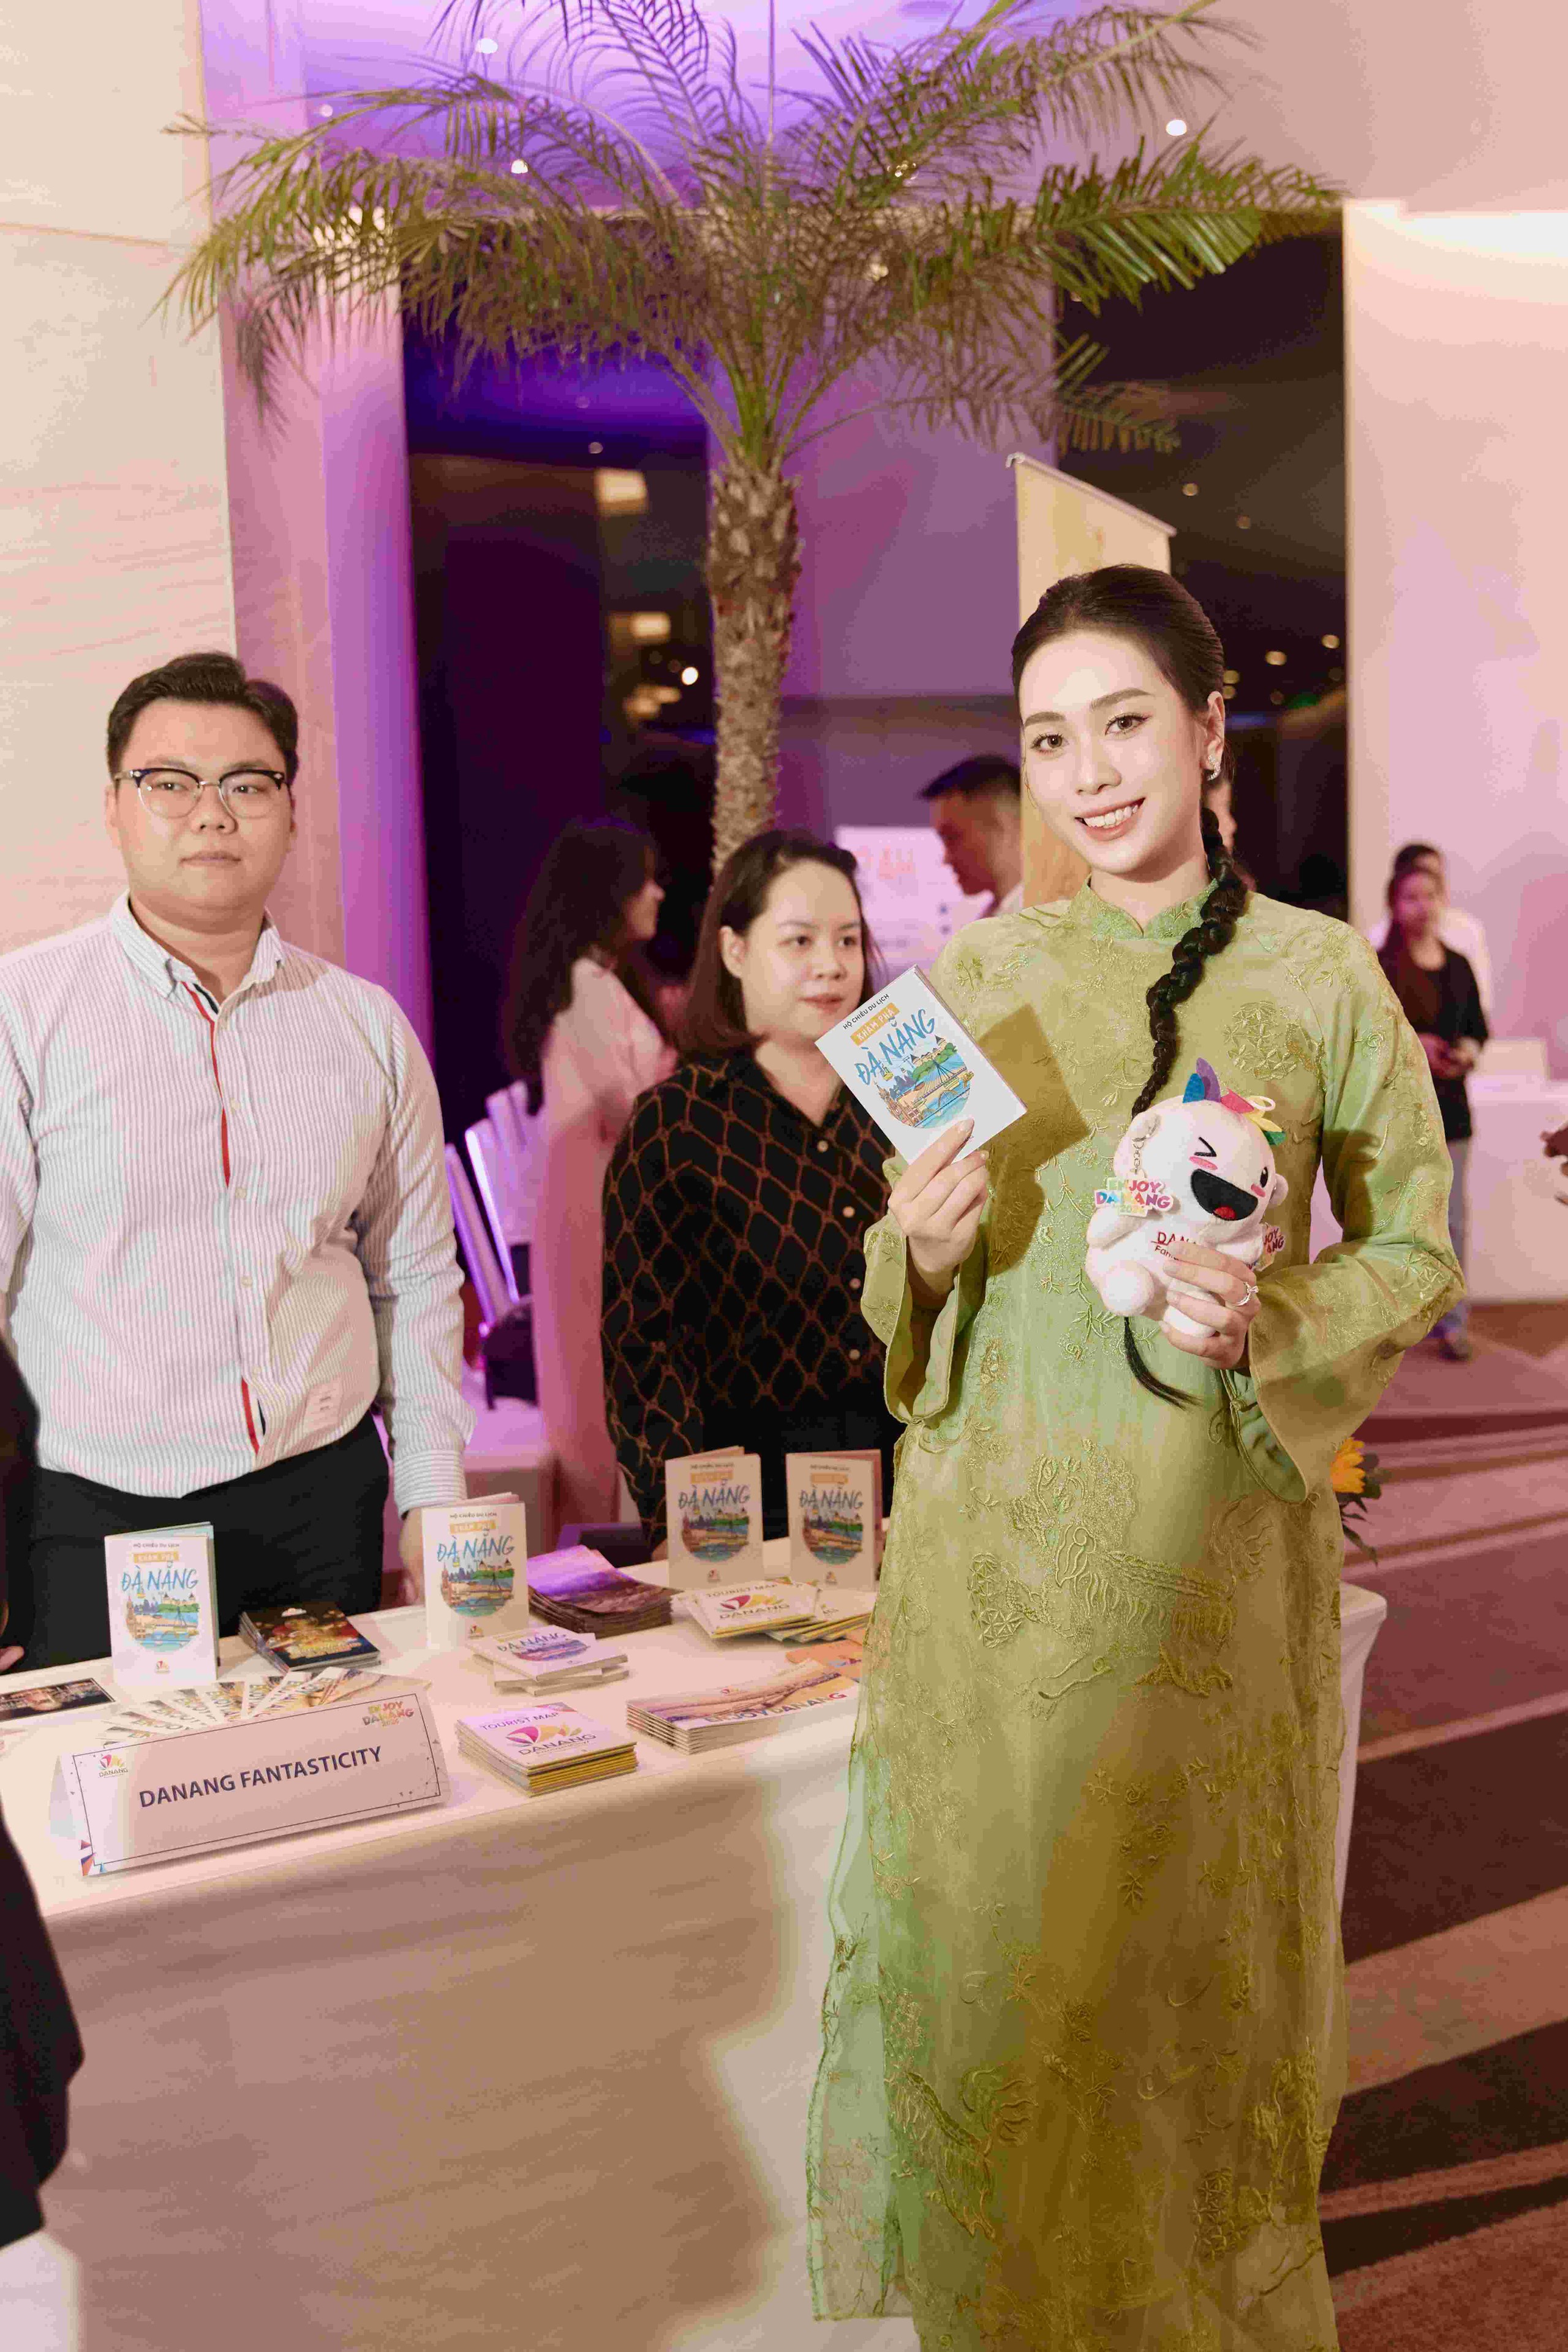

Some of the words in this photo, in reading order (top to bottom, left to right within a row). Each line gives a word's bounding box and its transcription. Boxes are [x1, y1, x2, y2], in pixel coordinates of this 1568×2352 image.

[843, 1020, 852, 1030] HỘ
[851, 1009, 869, 1023] CHIẾU
[868, 1003, 876, 1011] DU
[876, 993, 890, 1005] LỊCH
[854, 1046, 886, 1085] ĐÀ
[1108, 1180, 1161, 1193] ENJOY
[1096, 1191, 1171, 1209] DANANG
[1264, 1227, 1279, 1245] JOY
[480, 1717, 531, 1731] TOURIST
[518, 1733, 597, 1755] DANANG
[139, 1774, 236, 1808] DANANG
[239, 1746, 382, 1789] FANTASTICITY
